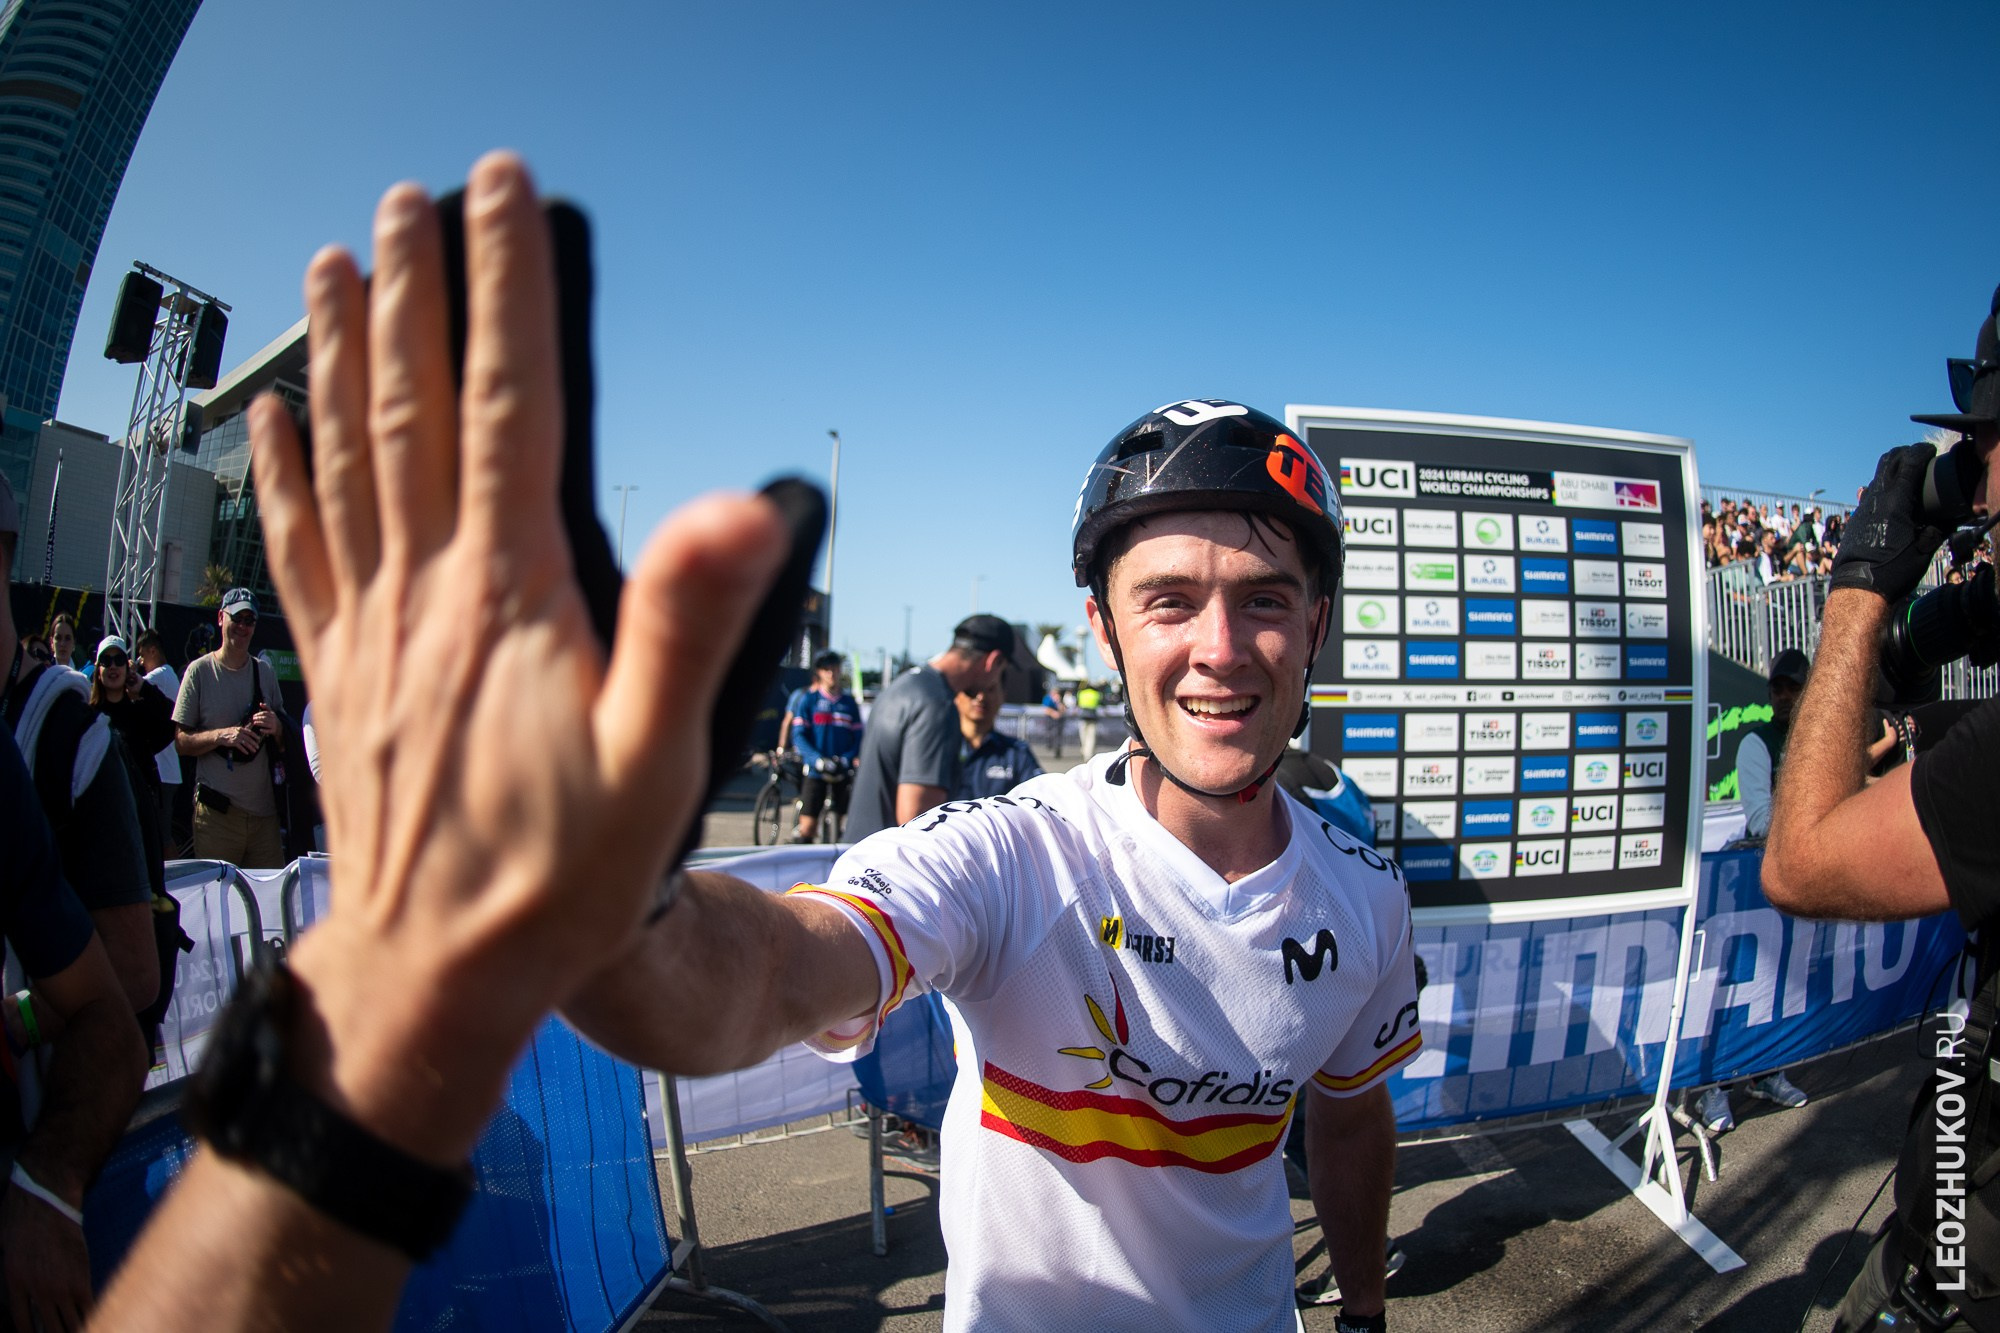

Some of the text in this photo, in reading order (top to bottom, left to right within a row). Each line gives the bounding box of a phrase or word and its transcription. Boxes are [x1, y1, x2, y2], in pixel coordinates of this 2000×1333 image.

[1355, 467, 1408, 489] UCI
[1419, 469, 1529, 486] 2024 URBAN CYCLING
[1560, 479, 1609, 491] ABU DHABI
[1420, 482, 1549, 500] WORLD CHAMPIONSHIPS
[1561, 491, 1578, 500] UAE
[1353, 518, 1392, 534] UCI
[1575, 531, 1615, 543] SHIMANO
[1524, 570, 1566, 581] SHIMANO
[1468, 611, 1513, 622] SHIMANO
[1579, 618, 1617, 628] TISSOT
[1409, 654, 1457, 666] SHIMANO
[1527, 660, 1566, 669] TISSOT
[1629, 657, 1666, 667] SHIMANO
[1346, 727, 1396, 738] SHIMANO
[1470, 731, 1511, 740] TISSOT
[1578, 725, 1618, 735] SHIMANO
[1523, 768, 1566, 779] SHIMANO
[1632, 762, 1663, 778] UCI
[1409, 775, 1453, 784] TISSOT
[1465, 813, 1510, 824] SHIMANO
[1581, 805, 1613, 821] UCI
[1526, 849, 1559, 866] UCI
[1624, 849, 1659, 859] TISSOT
[1404, 858, 1450, 869] SHIMANO
[1109, 1048, 1295, 1106] Cofidis
